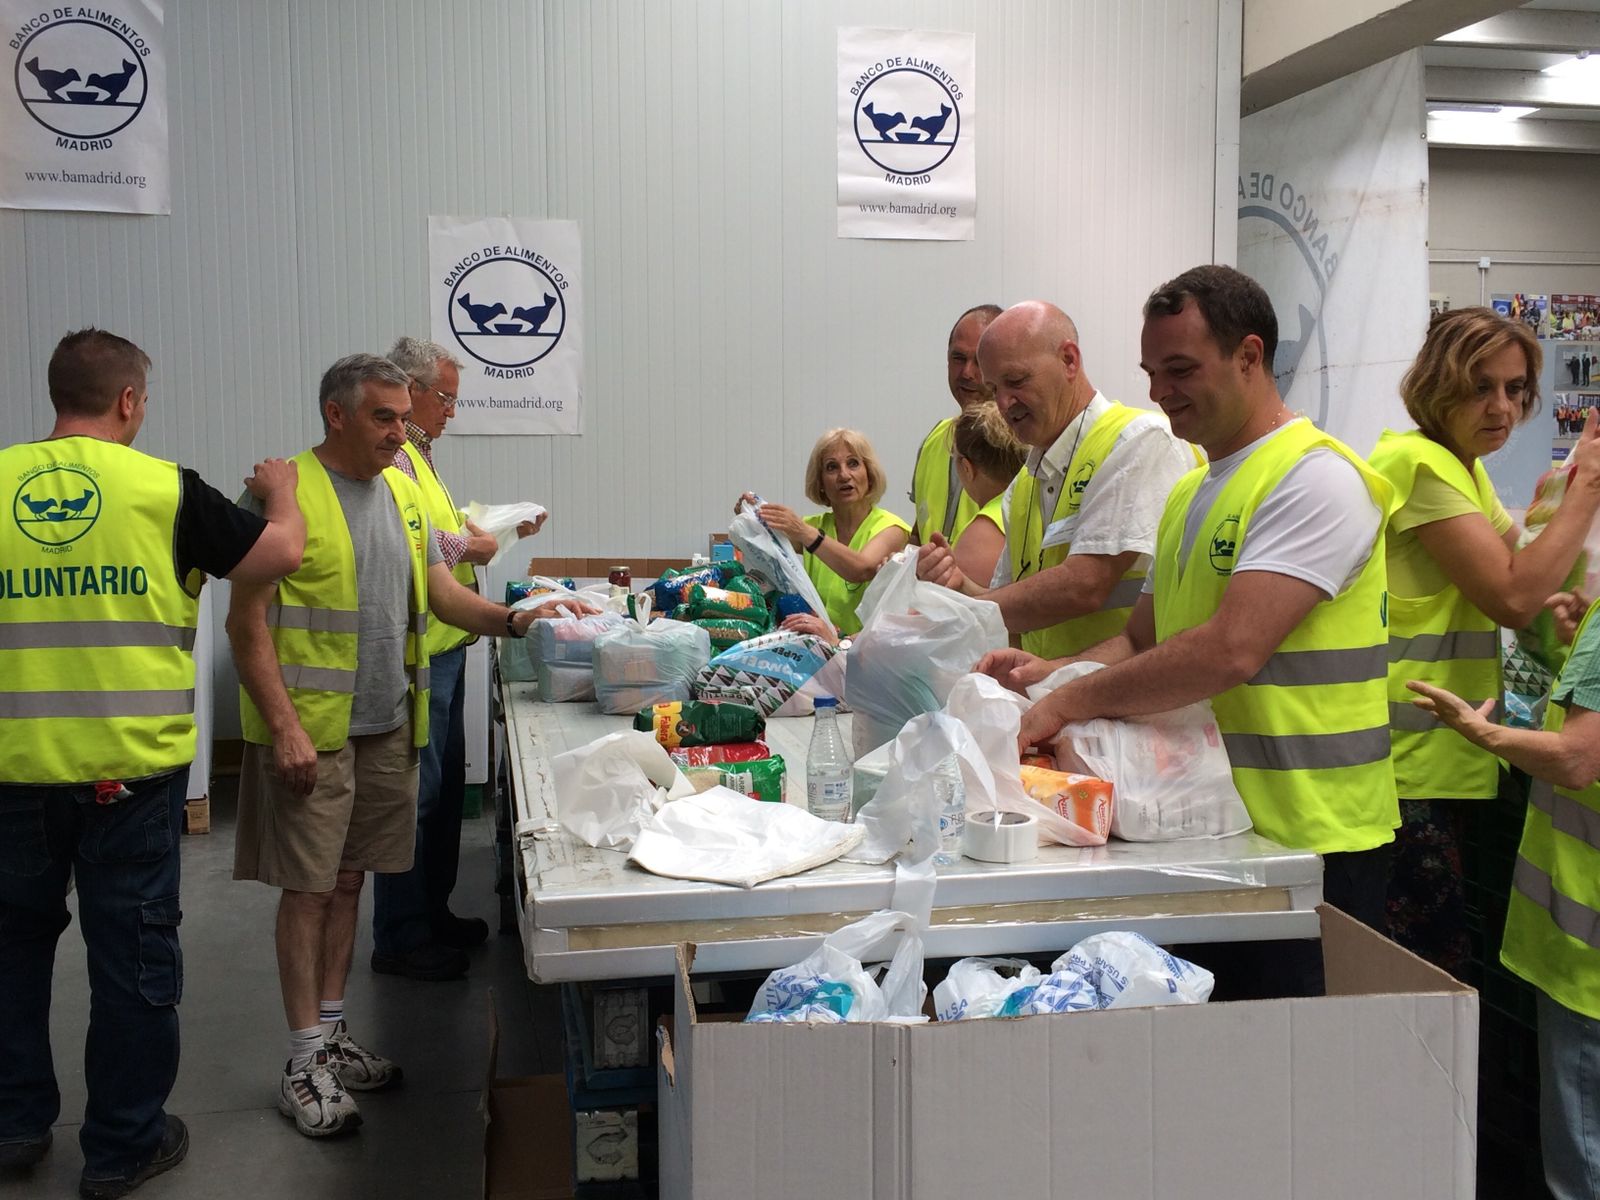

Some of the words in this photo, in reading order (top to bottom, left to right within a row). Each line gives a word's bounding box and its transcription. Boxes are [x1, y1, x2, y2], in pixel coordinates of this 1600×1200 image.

[9, 13, 50, 50] BANCO
[53, 7, 73, 19] DE
[77, 7, 151, 57] ALIMENTOS
[850, 62, 884, 97] BANCO
[886, 57, 902, 67] DE
[906, 57, 964, 101] ALIMENTOS
[55, 136, 113, 151] MADRID
[25, 169, 147, 188] www.bamadrid.org
[885, 173, 931, 186] MADRID
[859, 202, 957, 217] www.bamadrid.org
[444, 252, 480, 287] BANCO
[483, 246, 501, 257] DE
[505, 246, 569, 290] ALIMENTOS
[484, 366, 535, 379] MADRID
[456, 397, 564, 411] www.bamadrid.org
[17, 464, 45, 482] BANCO
[41, 545, 73, 555] MADRID
[0, 565, 148, 599] LUNTARIO
